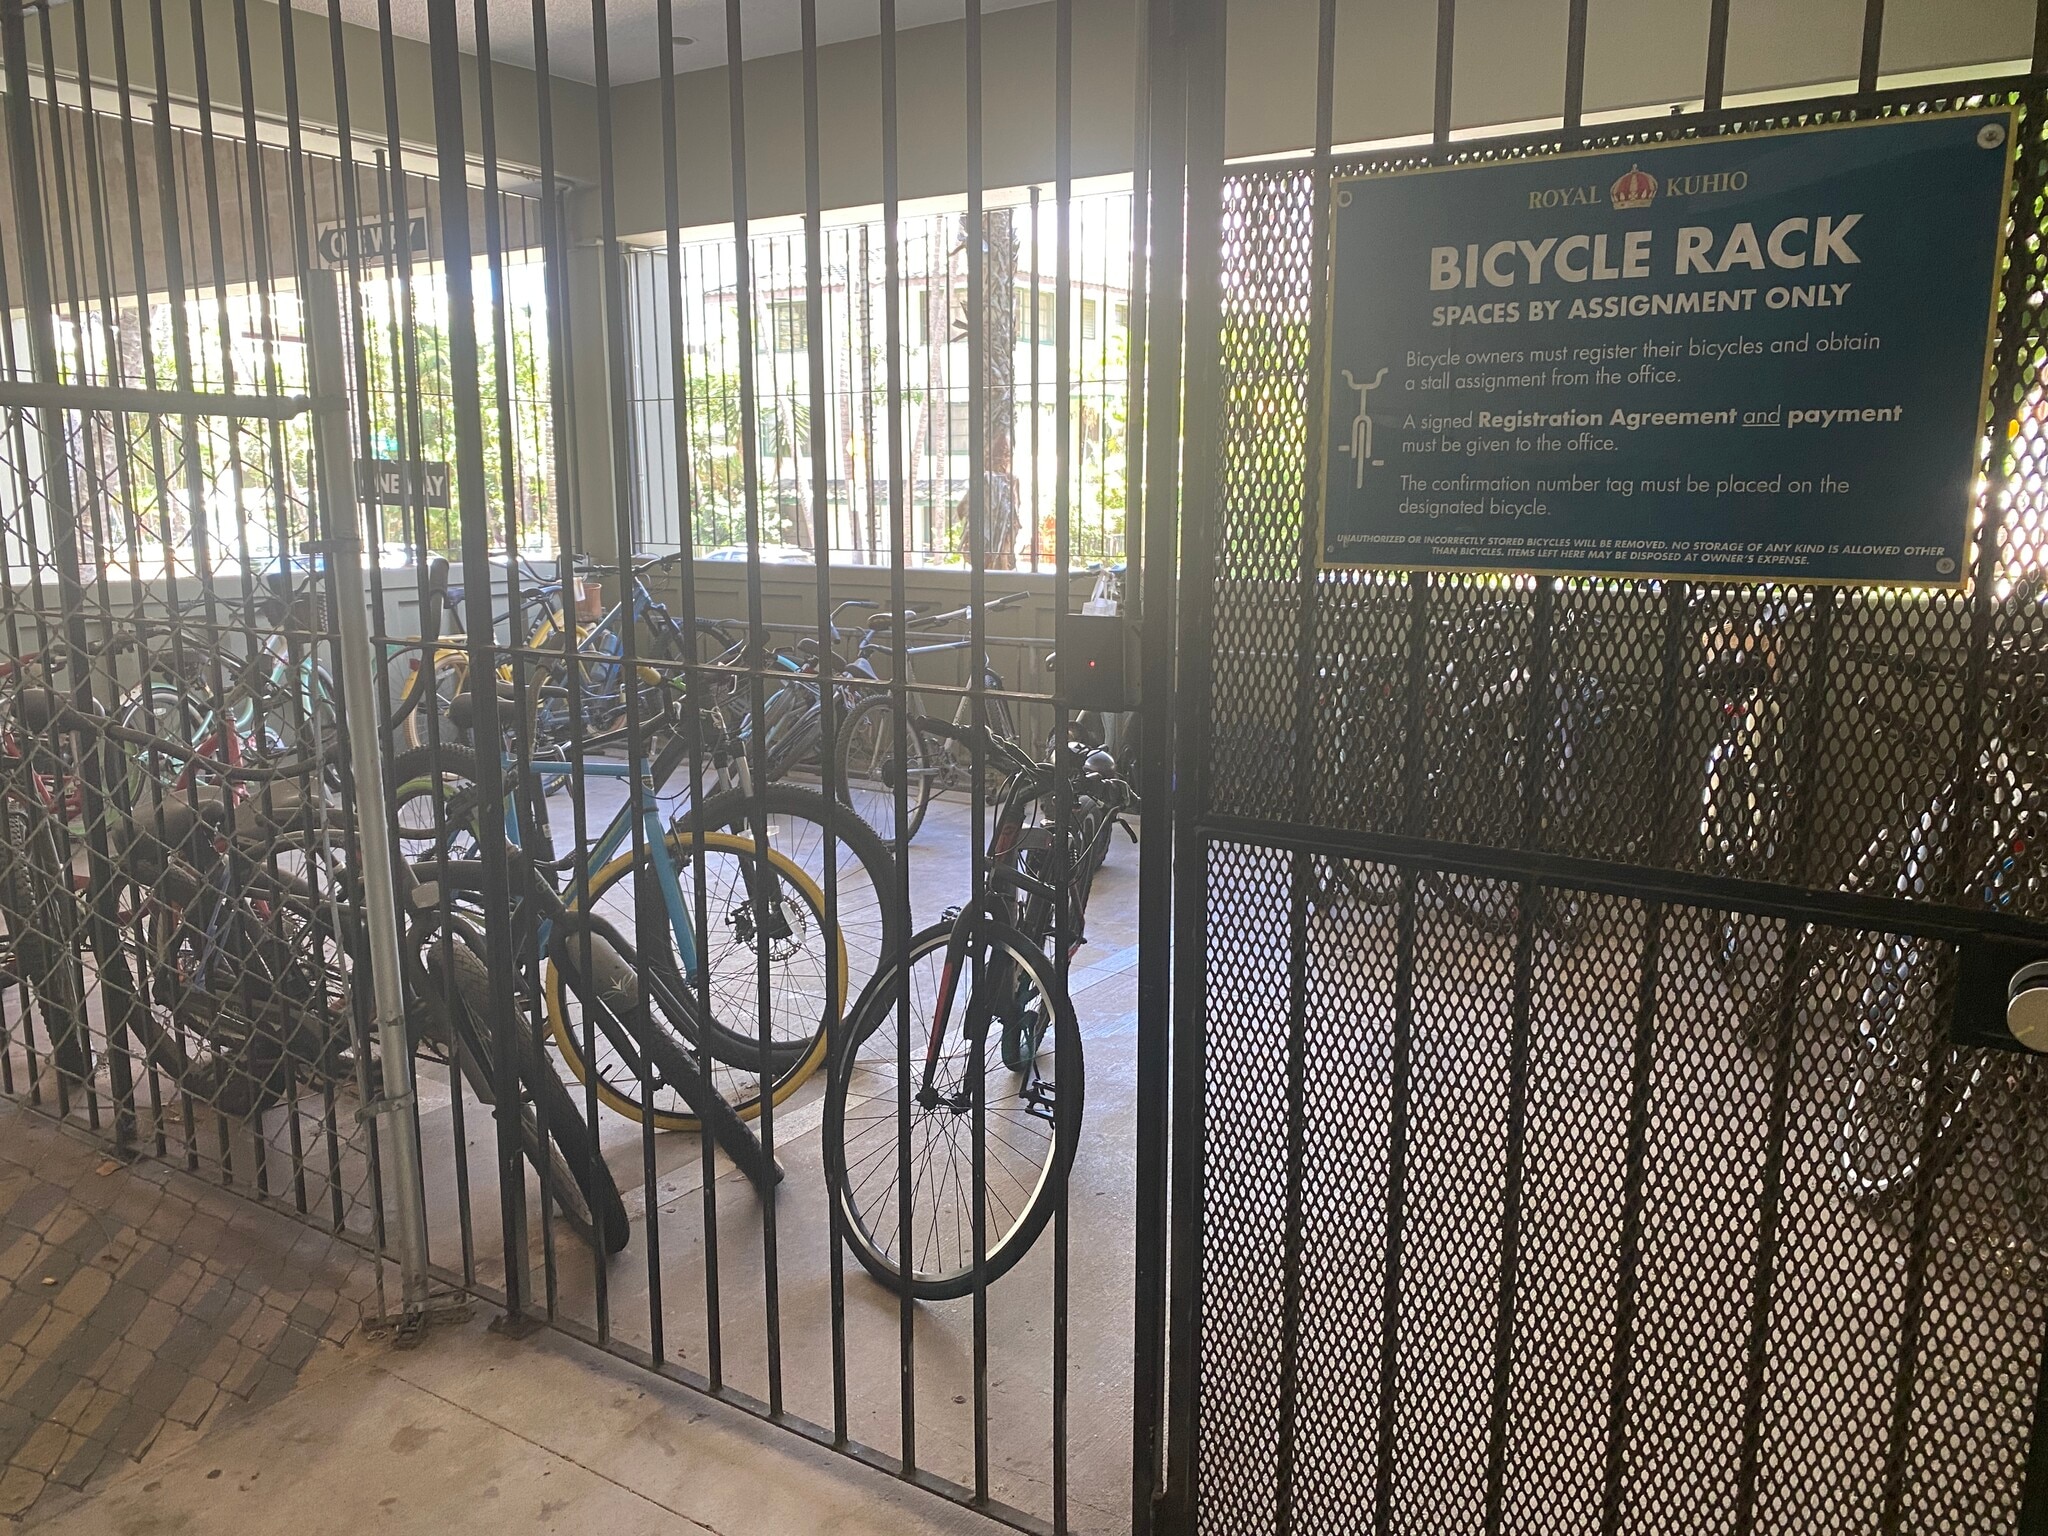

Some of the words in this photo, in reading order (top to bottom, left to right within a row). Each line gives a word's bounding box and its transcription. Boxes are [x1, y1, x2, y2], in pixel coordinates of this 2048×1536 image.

[1529, 185, 1602, 209] ROYAL
[1666, 171, 1748, 197] KUHIO
[1430, 231, 1652, 290] BICYCLE
[1675, 214, 1864, 275] RACK
[1432, 302, 1520, 326] SPACES
[1528, 300, 1561, 321] BY
[1568, 289, 1757, 319] ASSIGNMENT
[1765, 283, 1852, 309] ONLY
[1406, 348, 1460, 371] Bicycle
[1465, 350, 1524, 364] owners
[1530, 346, 1568, 362] must
[1573, 344, 1637, 364] register
[1643, 339, 1682, 357] their
[1688, 335, 1763, 360] bicycles
[1770, 332, 1809, 353] and
[1816, 331, 1881, 351] obtain
[1405, 379, 1415, 390] a
[1420, 372, 1450, 390] stall
[1455, 373, 1546, 392] assignment
[1552, 367, 1589, 386] from
[1595, 366, 1621, 384] the
[1627, 364, 1681, 383] office.
[1402, 414, 1416, 429] A
[1421, 411, 1473, 433] signed
[1478, 409, 1603, 432] Registration
[1609, 408, 1737, 430] Agreement
[1742, 404, 1781, 427] and
[1787, 405, 1903, 429] payment
[1402, 437, 1437, 452] must
[1441, 435, 1461, 452] be
[1466, 436, 1510, 456] given
[1516, 436, 1531, 451] to
[1536, 433, 1561, 451] the
[1567, 432, 1618, 451] office.
[1400, 474, 1427, 491] The
[1431, 473, 1530, 491] confirmation
[1536, 474, 1600, 491] number
[1605, 478, 1634, 497] tag
[1641, 477, 1681, 492] must
[1687, 474, 1710, 492] be
[1716, 473, 1781, 497] placed
[1787, 480, 1812, 493] on
[1820, 474, 1850, 493] the
[1398, 498, 1484, 519] designated
[1490, 498, 1551, 519] bicycle.
[1337, 534, 1406, 544] UNAUTHORIZED
[1408, 536, 1422, 544] OR
[1423, 536, 1486, 545] INCORRECTLY
[1488, 537, 1525, 546] STORED
[1526, 538, 1571, 547] BICYCLES
[1573, 539, 1598, 548] WILL
[1599, 539, 1613, 548] BE
[1614, 540, 1668, 550] REMOVED.
[1672, 541, 1691, 550] NO
[1693, 542, 1744, 551] STORAGE
[1747, 543, 1764, 552] OF
[1765, 543, 1793, 553] ANY
[1795, 544, 1826, 553] KIND
[1828, 545, 1840, 554] IS
[1842, 545, 1901, 555] ALLOWED
[1904, 546, 1945, 556] OTHER
[1431, 547, 1458, 555] THAN
[1460, 547, 1505, 557] BICYCLES.
[1507, 548, 1536, 557] ITEMS
[1537, 549, 1560, 558] LEFT
[1560, 550, 1586, 559] HERE
[1587, 550, 1613, 559] MAY
[1614, 551, 1628, 560] BE
[1629, 552, 1682, 561] DISPOSED
[1684, 553, 1700, 562] AT
[1757, 555, 1810, 565] EXPENSE.
